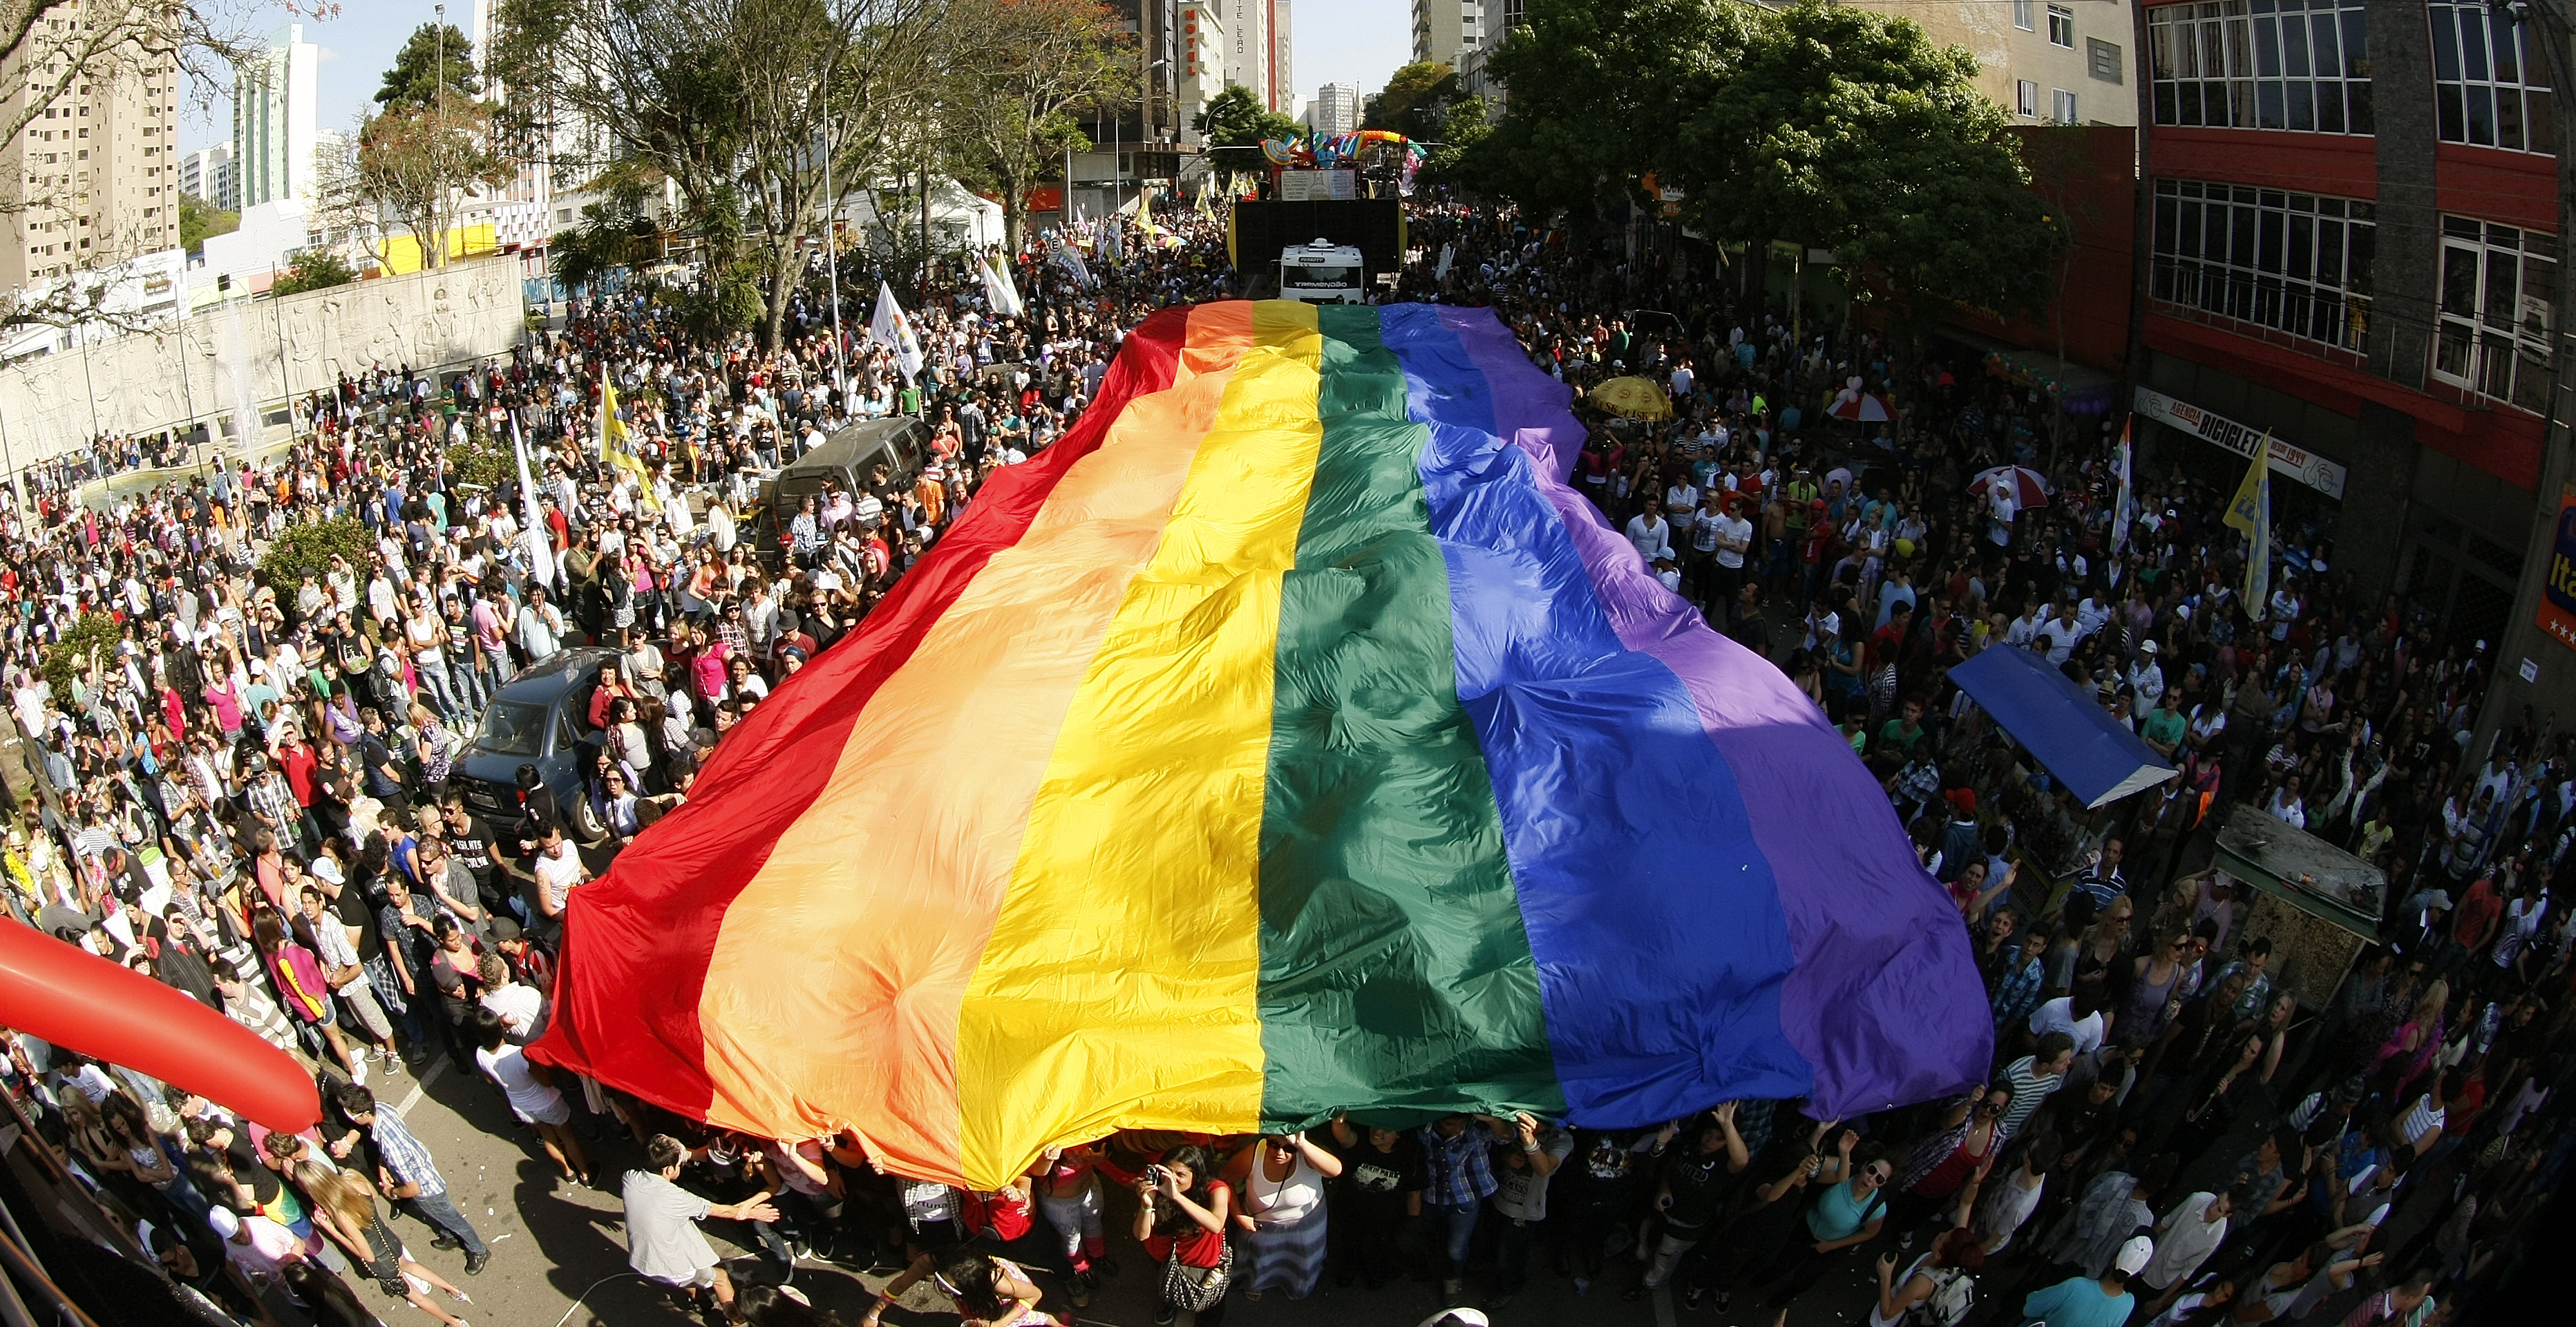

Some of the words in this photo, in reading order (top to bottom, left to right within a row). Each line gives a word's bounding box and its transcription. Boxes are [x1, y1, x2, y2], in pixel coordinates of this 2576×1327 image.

[1052, 241, 1058, 249] E
[1605, 402, 1629, 418] SKOL
[1636, 411, 1659, 421] SKOL
[2286, 447, 2307, 465] 1944
